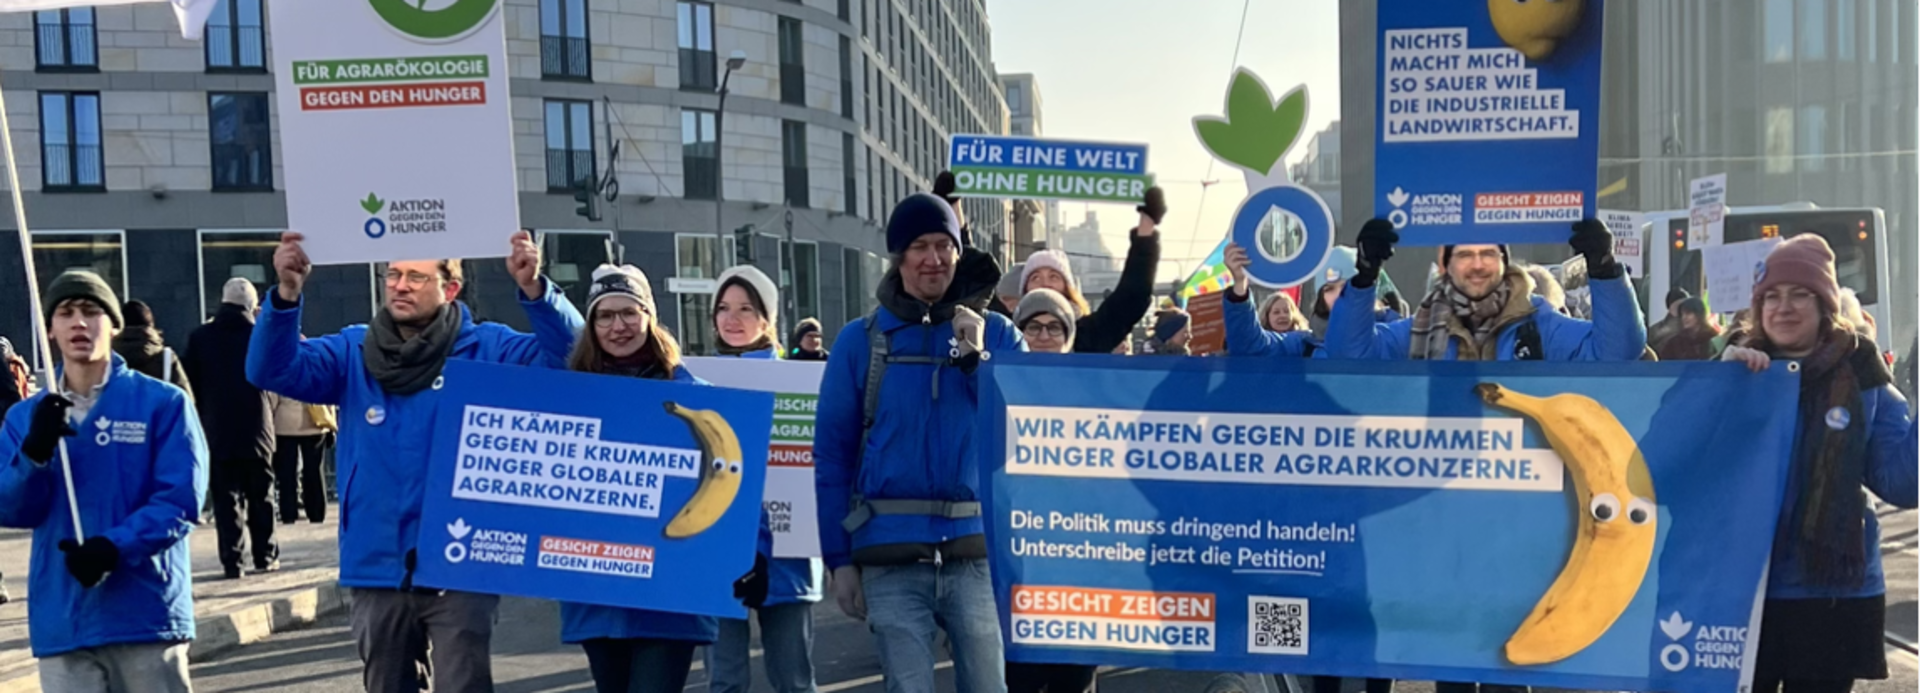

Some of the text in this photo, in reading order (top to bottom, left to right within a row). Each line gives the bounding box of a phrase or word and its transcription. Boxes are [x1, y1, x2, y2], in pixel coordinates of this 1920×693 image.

[1390, 33, 1463, 50] NICHTS
[296, 59, 484, 80] FÜR AGRARÖKOLOGIE
[1390, 53, 1520, 71] MACHT MICH
[1390, 74, 1532, 93] SO SAUER WIE
[305, 87, 481, 106] GEGEN DEN HUNGER
[1389, 94, 1560, 114] DIE INDUSTRIELLE
[1389, 115, 1574, 135] LANDWIRTSCHAFT.
[956, 139, 1139, 170] FÜR EINE WELT
[954, 170, 1145, 198] OHNE HUNGER
[389, 198, 445, 212] AKTION
[1411, 193, 1462, 205] AKTION
[1477, 193, 1582, 207] GESICHT ZEIGEN
[389, 212, 445, 222] GEGEN DEN
[1411, 213, 1462, 225] HUNGER
[1477, 207, 1581, 221] GEGEN HUNGER
[390, 221, 446, 234] HUNGER
[468, 411, 596, 439] ICH KÄMPFE
[770, 424, 815, 437] AGRA
[1015, 414, 1513, 451] WIR KÄMPFEN GEGEN DIE KRUMMEN
[465, 433, 696, 471] GEGEN DIE KRUMMEN
[462, 455, 658, 489] DINGER GLOBALER
[1015, 444, 1541, 481] DINGER GLOBALER AGRARKONZERNE.
[458, 475, 655, 512] AGRARKONZERNE.
[763, 501, 791, 512] ION
[472, 528, 528, 545] AKTION
[1010, 510, 1356, 546] Die Politik muss dringend handeln!
[471, 541, 526, 554] GEGEN DEN
[543, 537, 655, 561] GESICHT ZEIGEN
[1010, 538, 1326, 570] Unterschreibe jetzt die Petition!
[469, 549, 525, 566] HUNGER
[541, 554, 651, 576] GEGEN HUNGER
[1015, 590, 1210, 617] GESICHT ZEIGEN
[1015, 619, 1210, 646] GEGEN HUNGER
[1695, 641, 1739, 654] GEGEN
